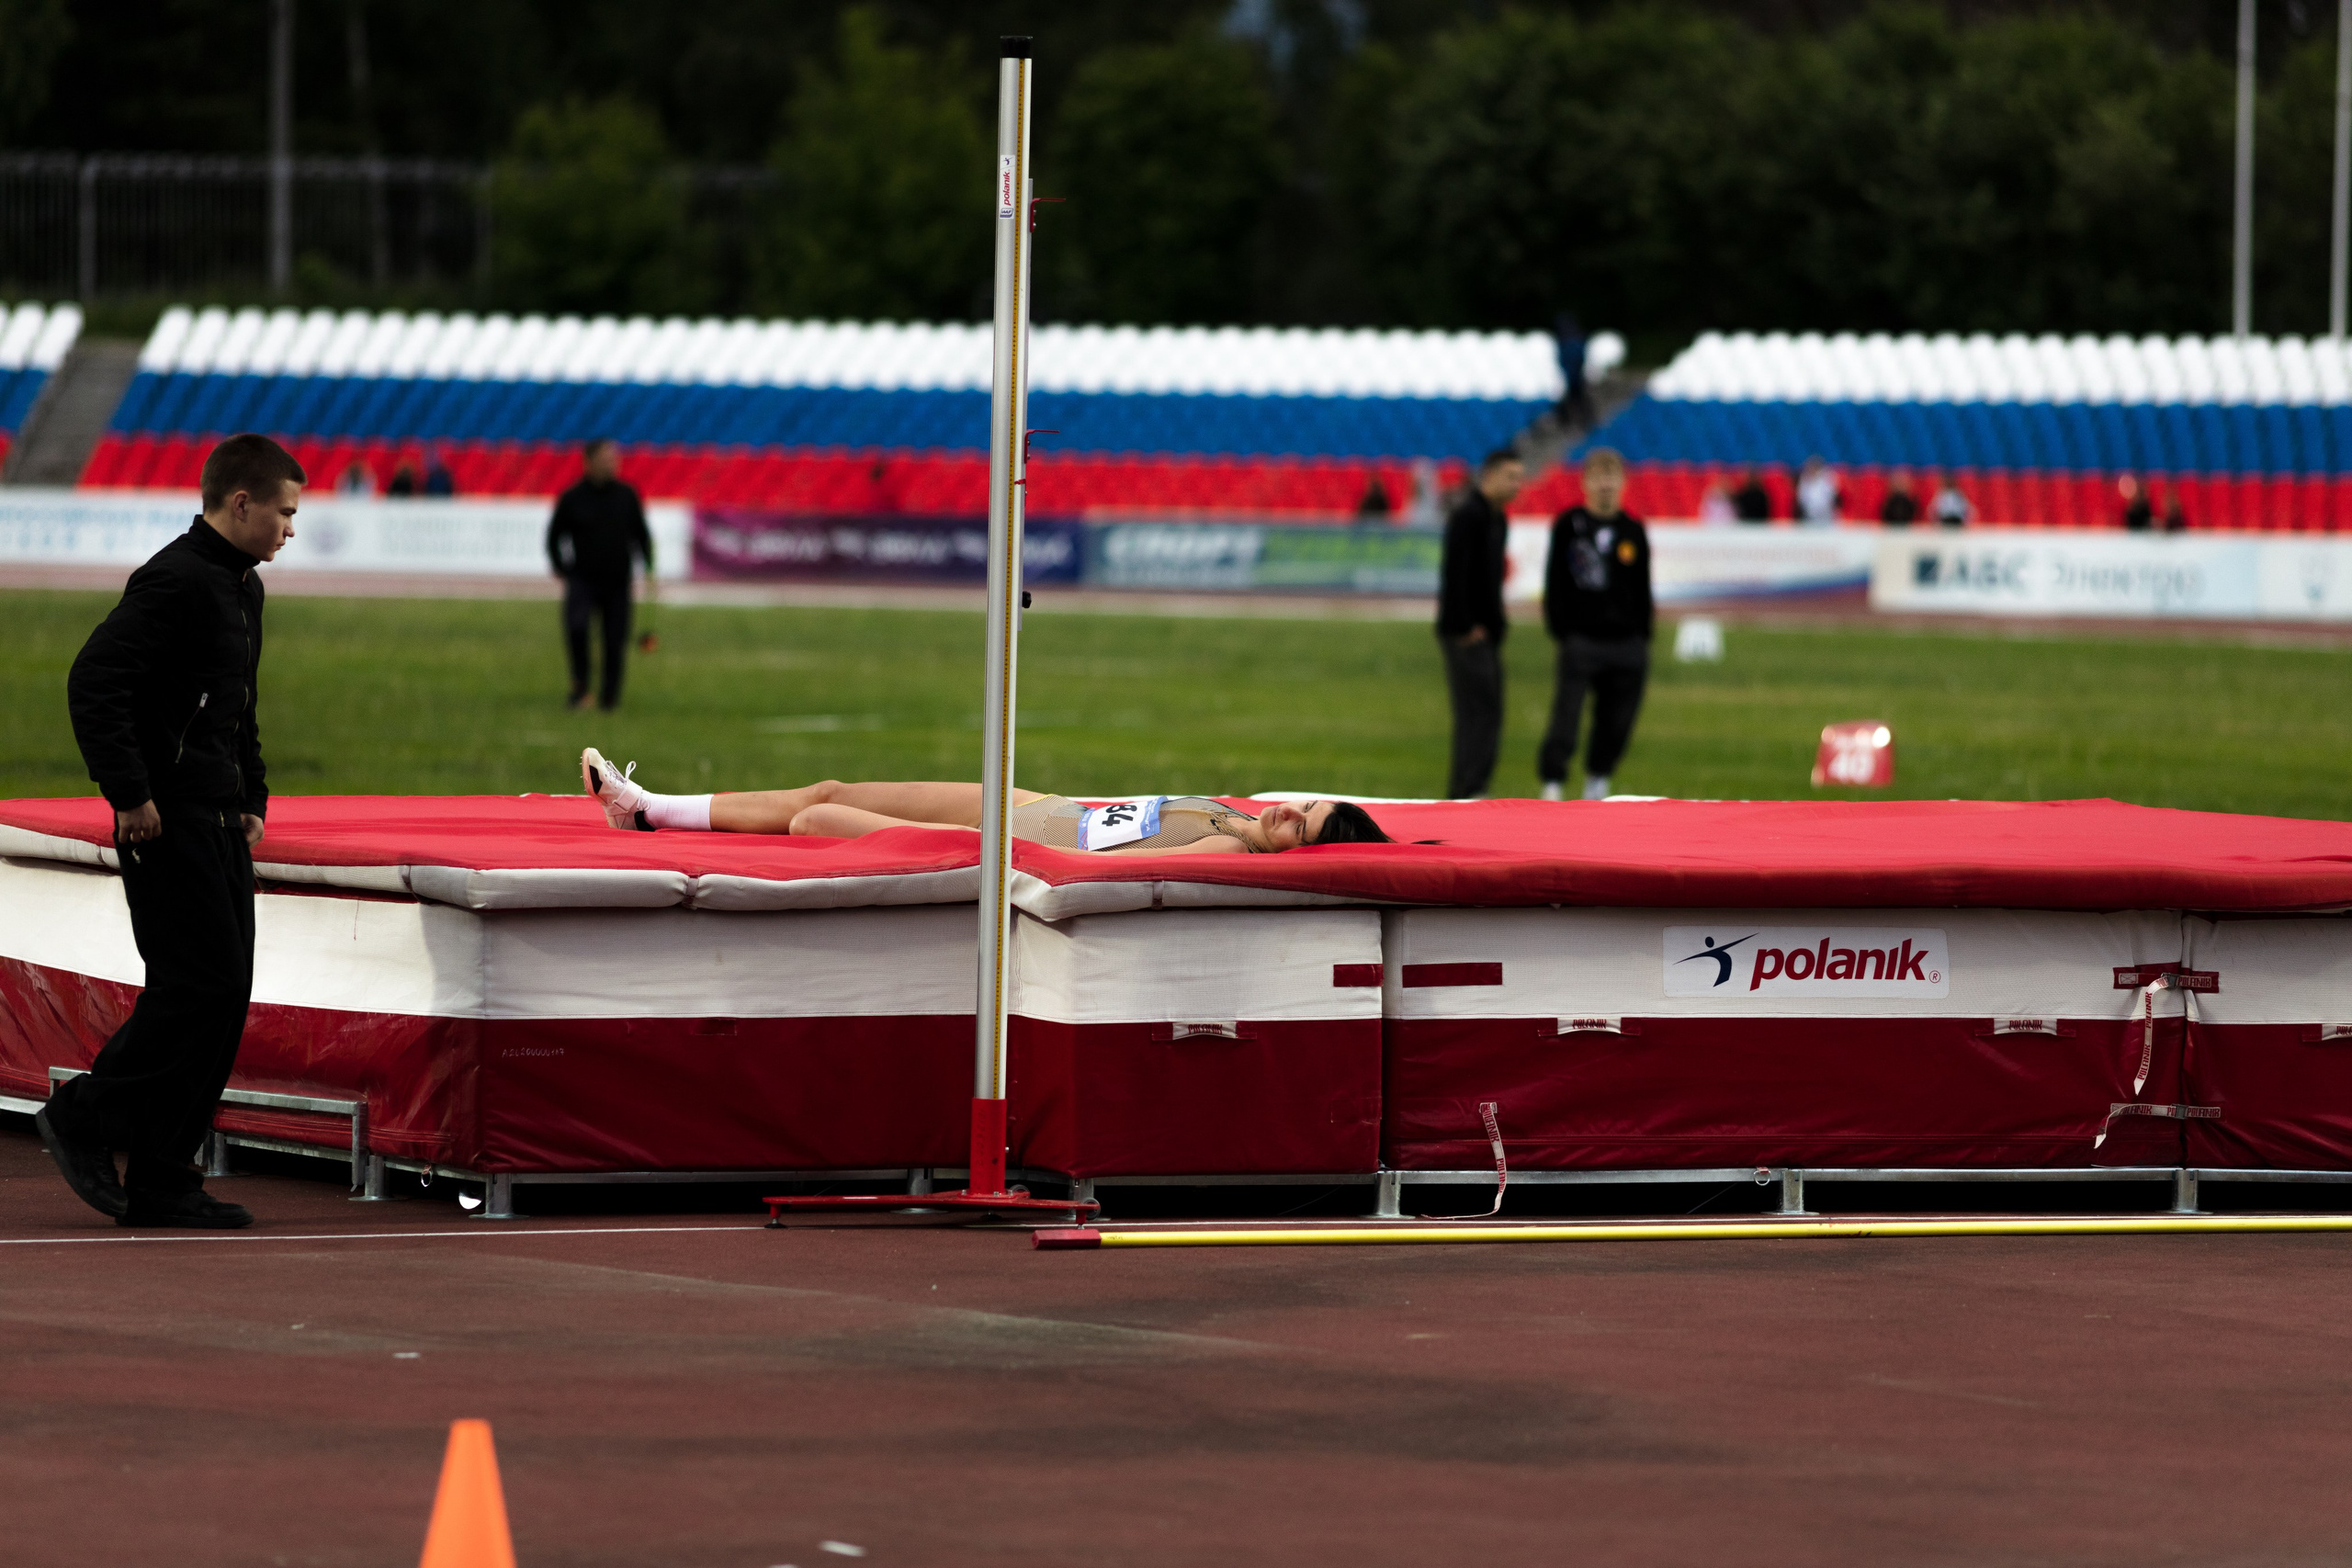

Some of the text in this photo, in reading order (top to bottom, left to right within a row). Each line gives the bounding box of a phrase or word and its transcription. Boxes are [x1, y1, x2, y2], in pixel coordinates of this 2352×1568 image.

[1002, 172, 1012, 206] polanik
[1749, 937, 1929, 991] polanik
[2008, 1020, 2042, 1030] POLANIK
[2137, 1043, 2151, 1080] POLANIK
